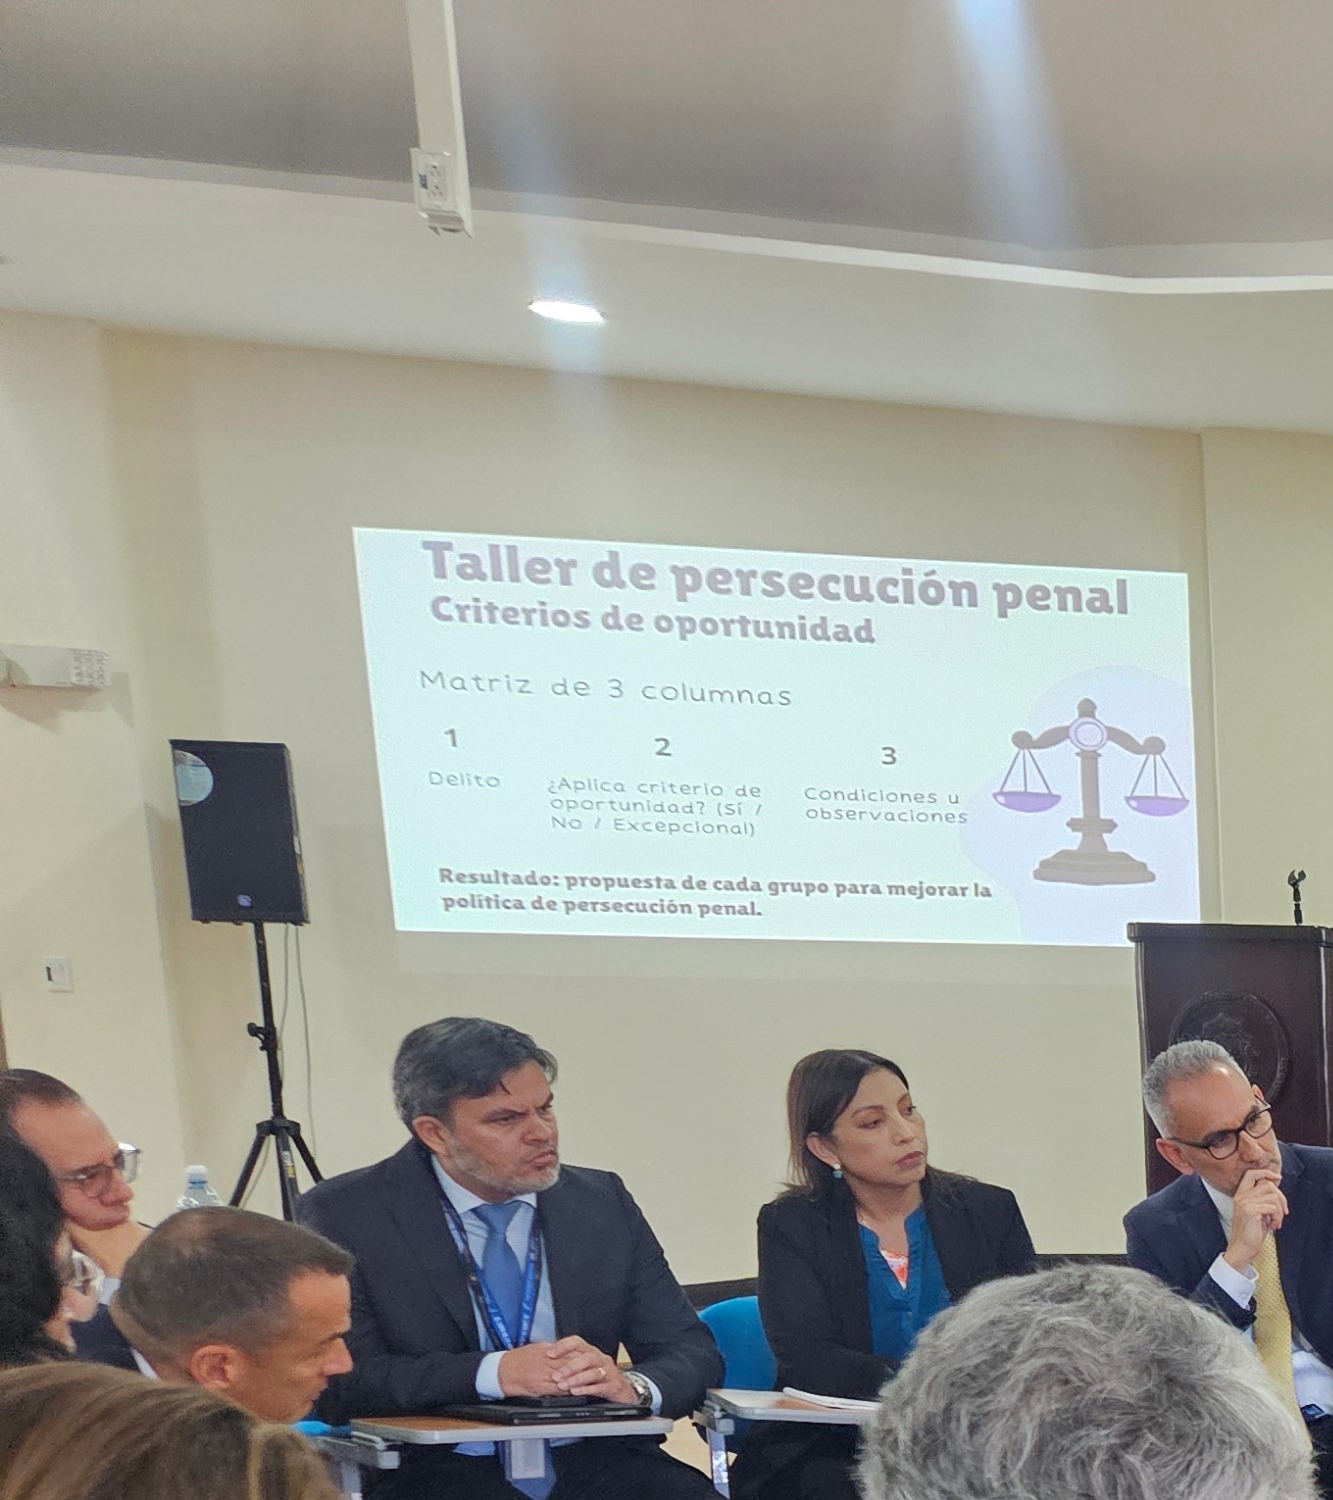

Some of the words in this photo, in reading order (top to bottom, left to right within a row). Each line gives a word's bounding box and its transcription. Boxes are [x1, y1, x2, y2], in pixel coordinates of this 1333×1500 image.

[420, 539, 579, 587] Taller
[591, 549, 657, 591] de
[669, 564, 979, 609] persecución
[991, 578, 1129, 619] penal
[430, 595, 592, 630] Criterios
[600, 603, 645, 632] de
[653, 614, 877, 645] oportunidad
[419, 669, 534, 695] Matriz
[551, 677, 591, 697] de
[607, 678, 624, 699] 3
[641, 682, 792, 707] columnas
[444, 728, 459, 748] 1
[654, 737, 673, 757] 2
[881, 746, 897, 766] 3
[428, 770, 501, 788] Delito
[547, 777, 626, 795] ¿Aplica
[636, 781, 724, 797] criterio
[734, 784, 761, 798] de
[803, 787, 938, 804] Condiciones
[549, 798, 705, 819] oportunidad?
[716, 801, 743, 818] (Sí
[755, 803, 763, 816] /
[805, 807, 969, 824] observaciones
[551, 815, 583, 830] No
[593, 817, 602, 830] /
[613, 817, 755, 838] Excepcional)
[438, 867, 560, 887] Resultado:
[563, 875, 678, 892] propuesta
[681, 874, 708, 891] de
[712, 876, 763, 893] cada
[767, 881, 829, 897] grupo
[833, 882, 883, 898] para
[886, 880, 969, 900] mejorar
[973, 882, 993, 898] la
[440, 893, 527, 913] política
[530, 895, 558, 912] de
[562, 898, 693, 916] persecución
[697, 900, 763, 919] penal.
